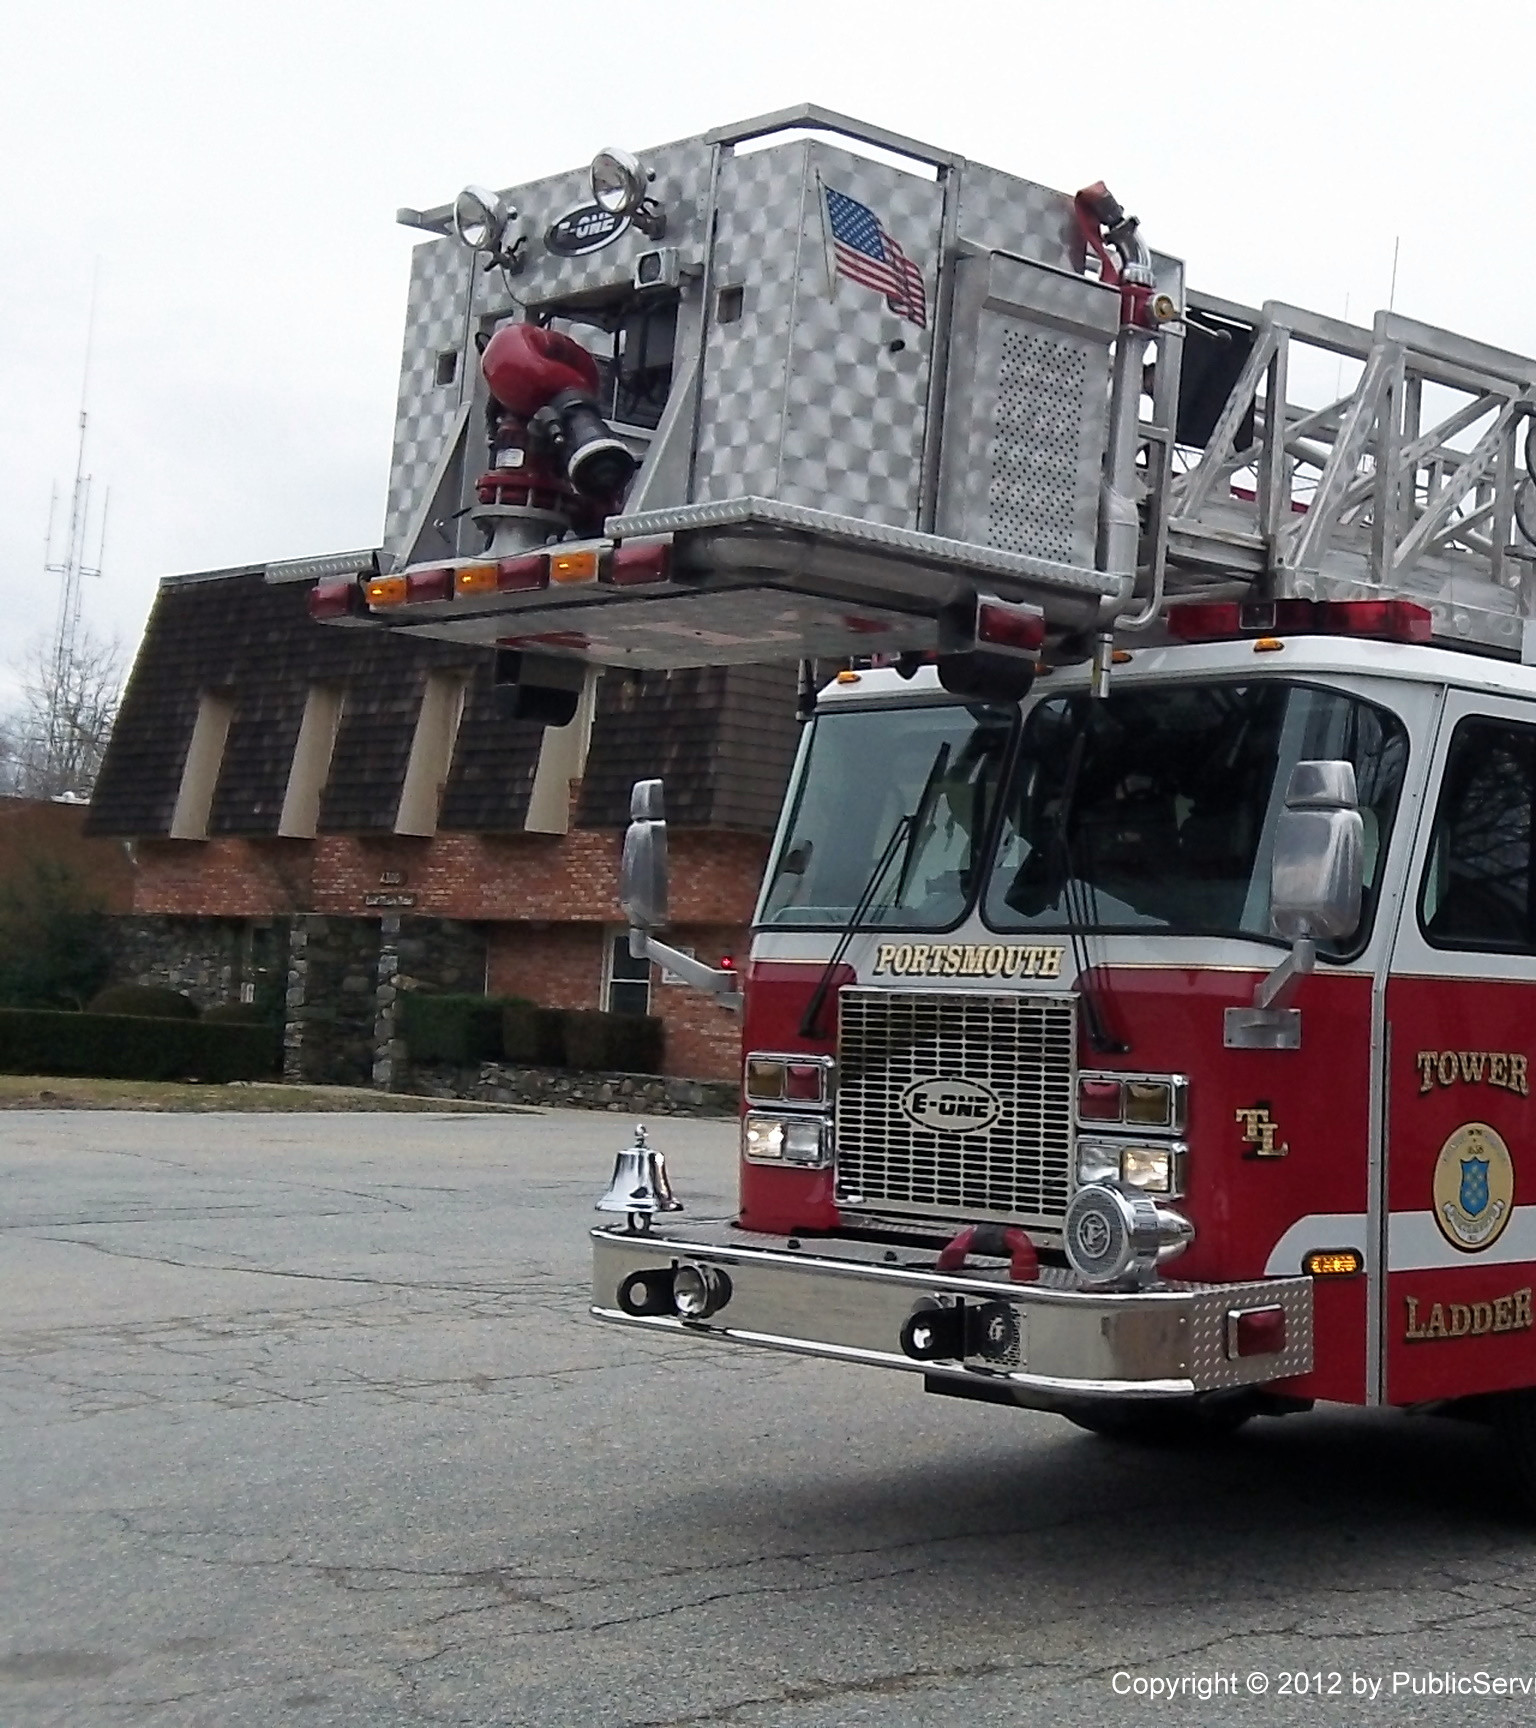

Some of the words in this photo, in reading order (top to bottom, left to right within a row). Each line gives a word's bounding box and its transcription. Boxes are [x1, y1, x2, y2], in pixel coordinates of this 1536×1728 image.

[873, 943, 1066, 980] PORTSMOUTH
[1416, 1050, 1530, 1097] TOWER
[911, 1092, 991, 1119] E-ONE
[1405, 1286, 1535, 1342] LADDER
